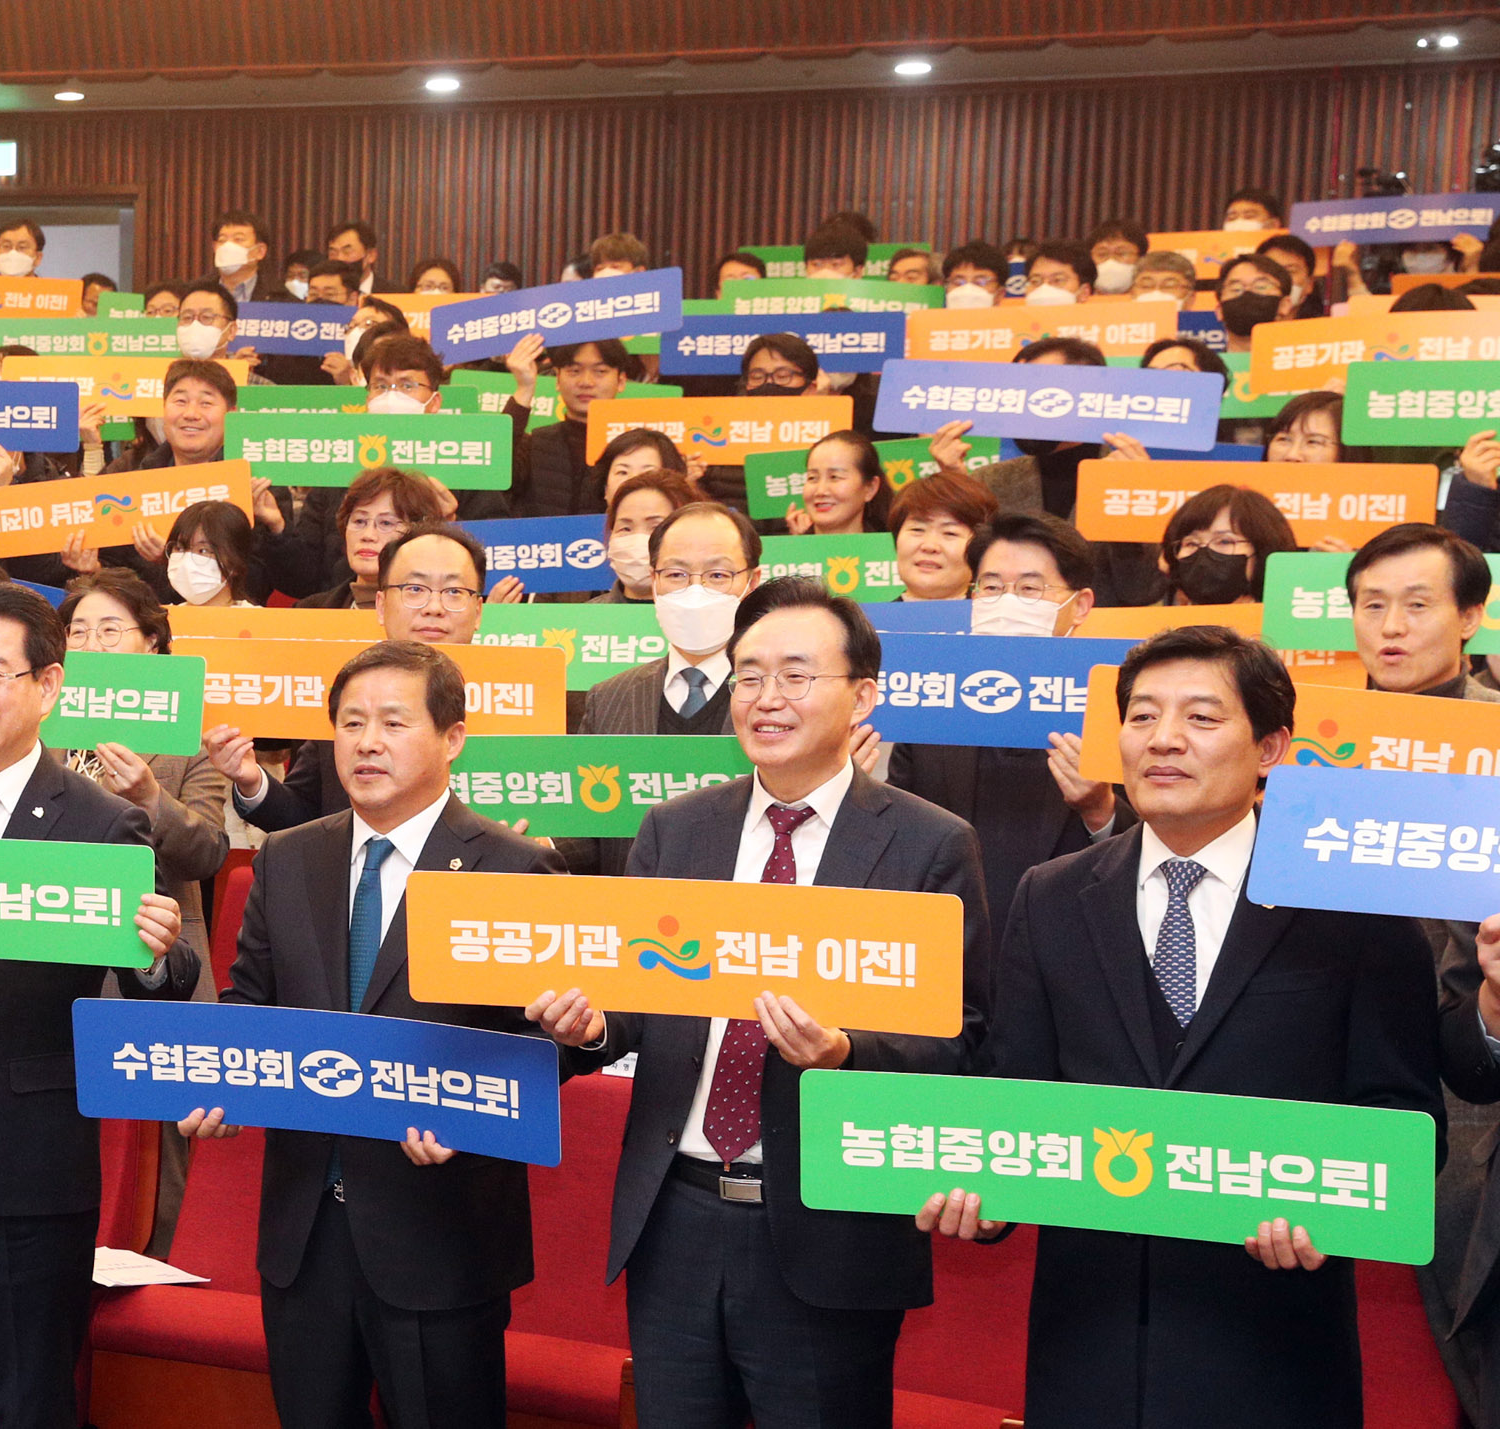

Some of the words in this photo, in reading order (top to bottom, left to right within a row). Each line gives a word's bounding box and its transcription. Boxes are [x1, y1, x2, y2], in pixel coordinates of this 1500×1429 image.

[1304, 212, 1387, 233] 수협중앙회
[1419, 208, 1493, 227] 전남으로!
[4, 291, 31, 308] 전남
[35, 294, 68, 311] 이전!
[447, 308, 536, 345] 수협중앙회
[575, 291, 660, 322] 전남으로!
[235, 320, 290, 338] 협중앙회
[678, 334, 755, 356] 수협중앙
[806, 332, 886, 353] 전남으로!
[929, 328, 1013, 351] 공공기관
[1105, 322, 1155, 345] 이전!
[1272, 340, 1366, 370] 공공기관
[1418, 336, 1471, 361] 전남
[902, 385, 1027, 414] 수협중앙회
[1077, 391, 1192, 424] 전남으로!
[729, 421, 773, 444] 전남
[779, 421, 830, 444] 이전!
[243, 438, 354, 463] 농협중앙회
[391, 441, 491, 466] 전남으로!
[50, 500, 94, 527] 전남
[1104, 488, 1198, 516] 공공기
[1273, 491, 1331, 521] 전남
[1338, 493, 1405, 523] 이전!
[581, 634, 666, 664] 전남으
[59, 686, 178, 722] 전남으로!
[203, 674, 325, 708] 공공기관
[465, 681, 534, 716] 이전!
[1368, 735, 1454, 775] 전남
[449, 771, 572, 805] 협중앙회
[1303, 817, 1500, 874] 수협중앙
[449, 919, 622, 969] 공공기관
[714, 930, 803, 978] 전남
[816, 937, 916, 988] 이전!
[112, 1042, 294, 1090] 수협중앙회
[370, 1058, 520, 1119] 전남으로!
[840, 1121, 1084, 1182] 농협중앙회
[1164, 1142, 1388, 1212] 전남으로!
